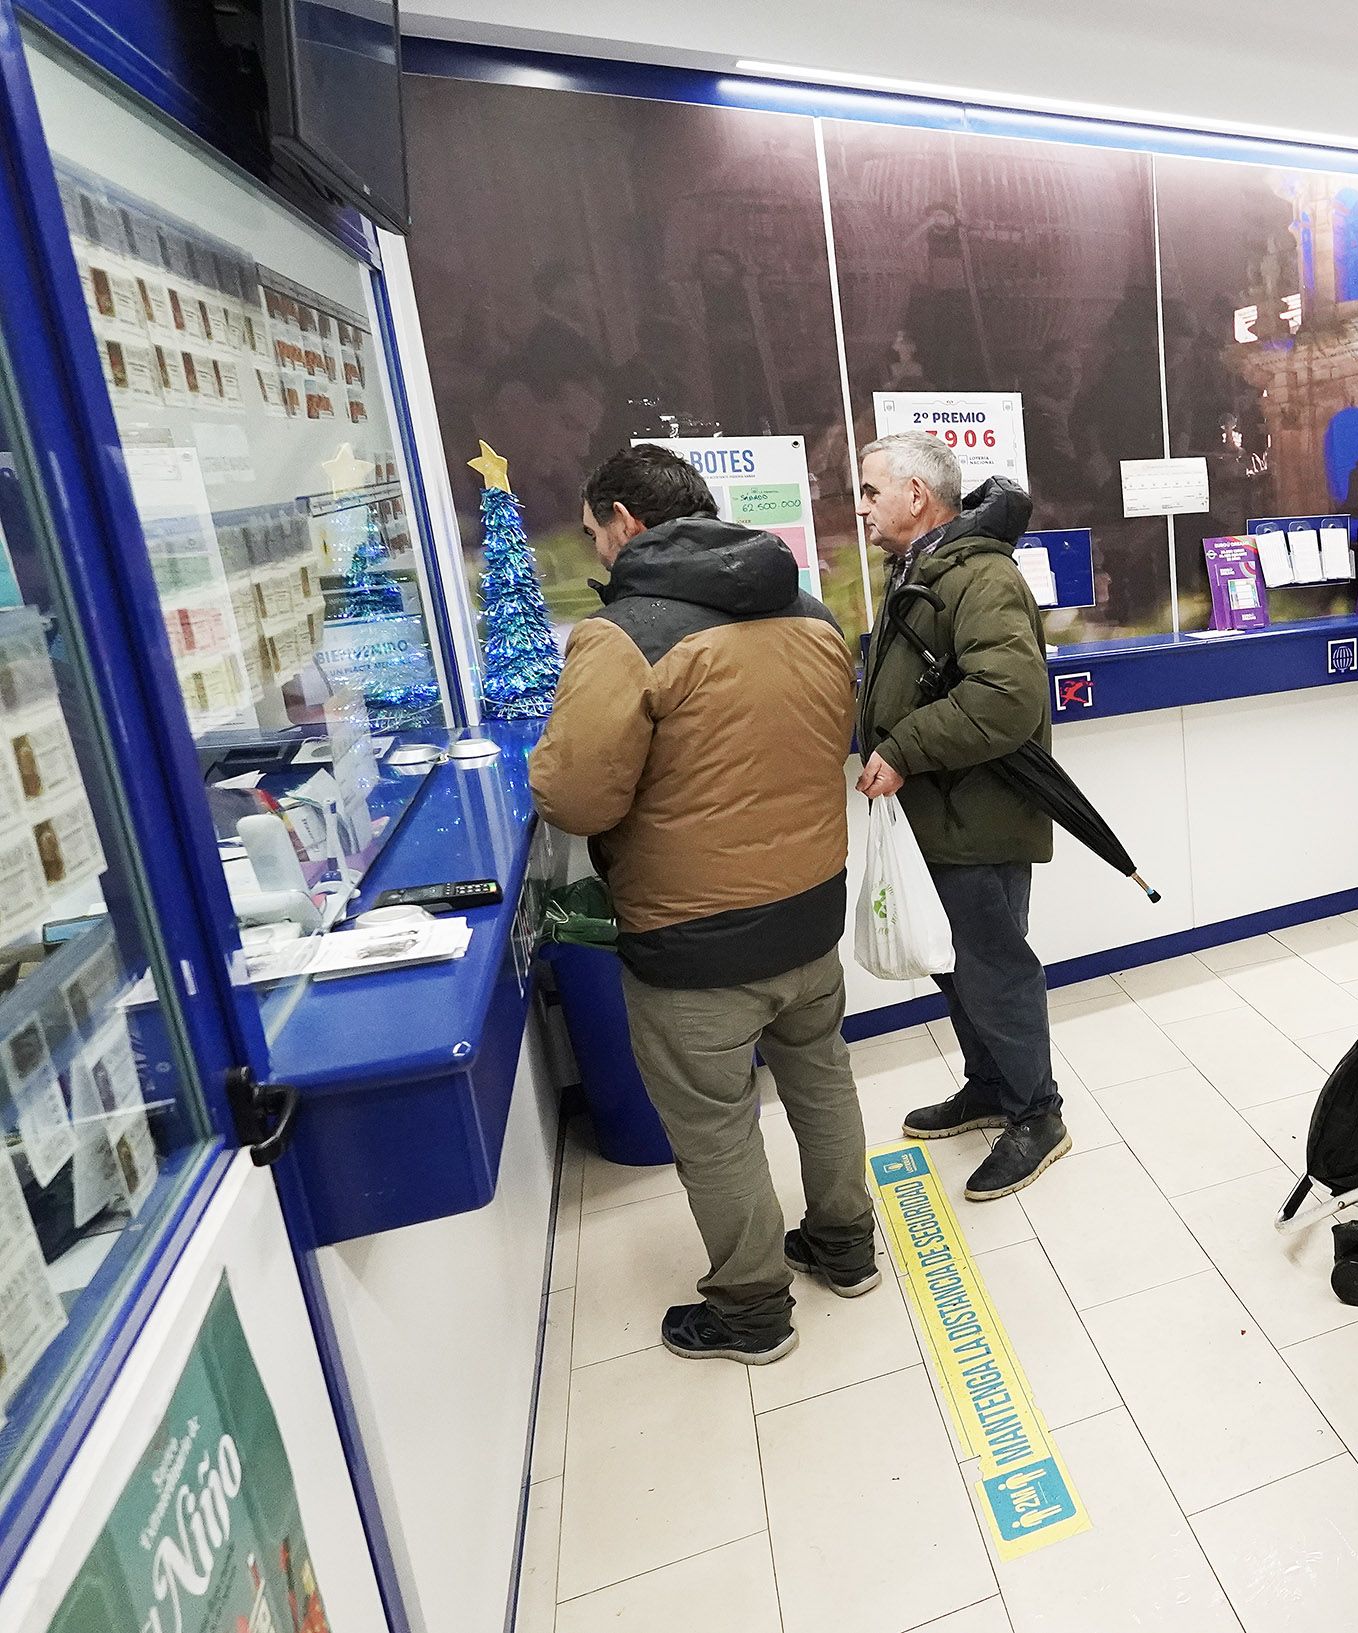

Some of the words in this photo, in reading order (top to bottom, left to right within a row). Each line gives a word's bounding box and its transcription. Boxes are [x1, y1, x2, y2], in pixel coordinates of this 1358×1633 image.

[913, 412, 929, 423] 2º
[932, 412, 986, 423] PREMIO
[894, 1180, 945, 1248] SEGURIDAD
[917, 1244, 953, 1268] DE
[925, 1263, 983, 1341] DISTANCIA
[953, 1336, 992, 1364] LA
[962, 1359, 1034, 1466] MANTENGA
[1010, 1486, 1041, 1513] 2M
[152, 1433, 242, 1632] Niño
